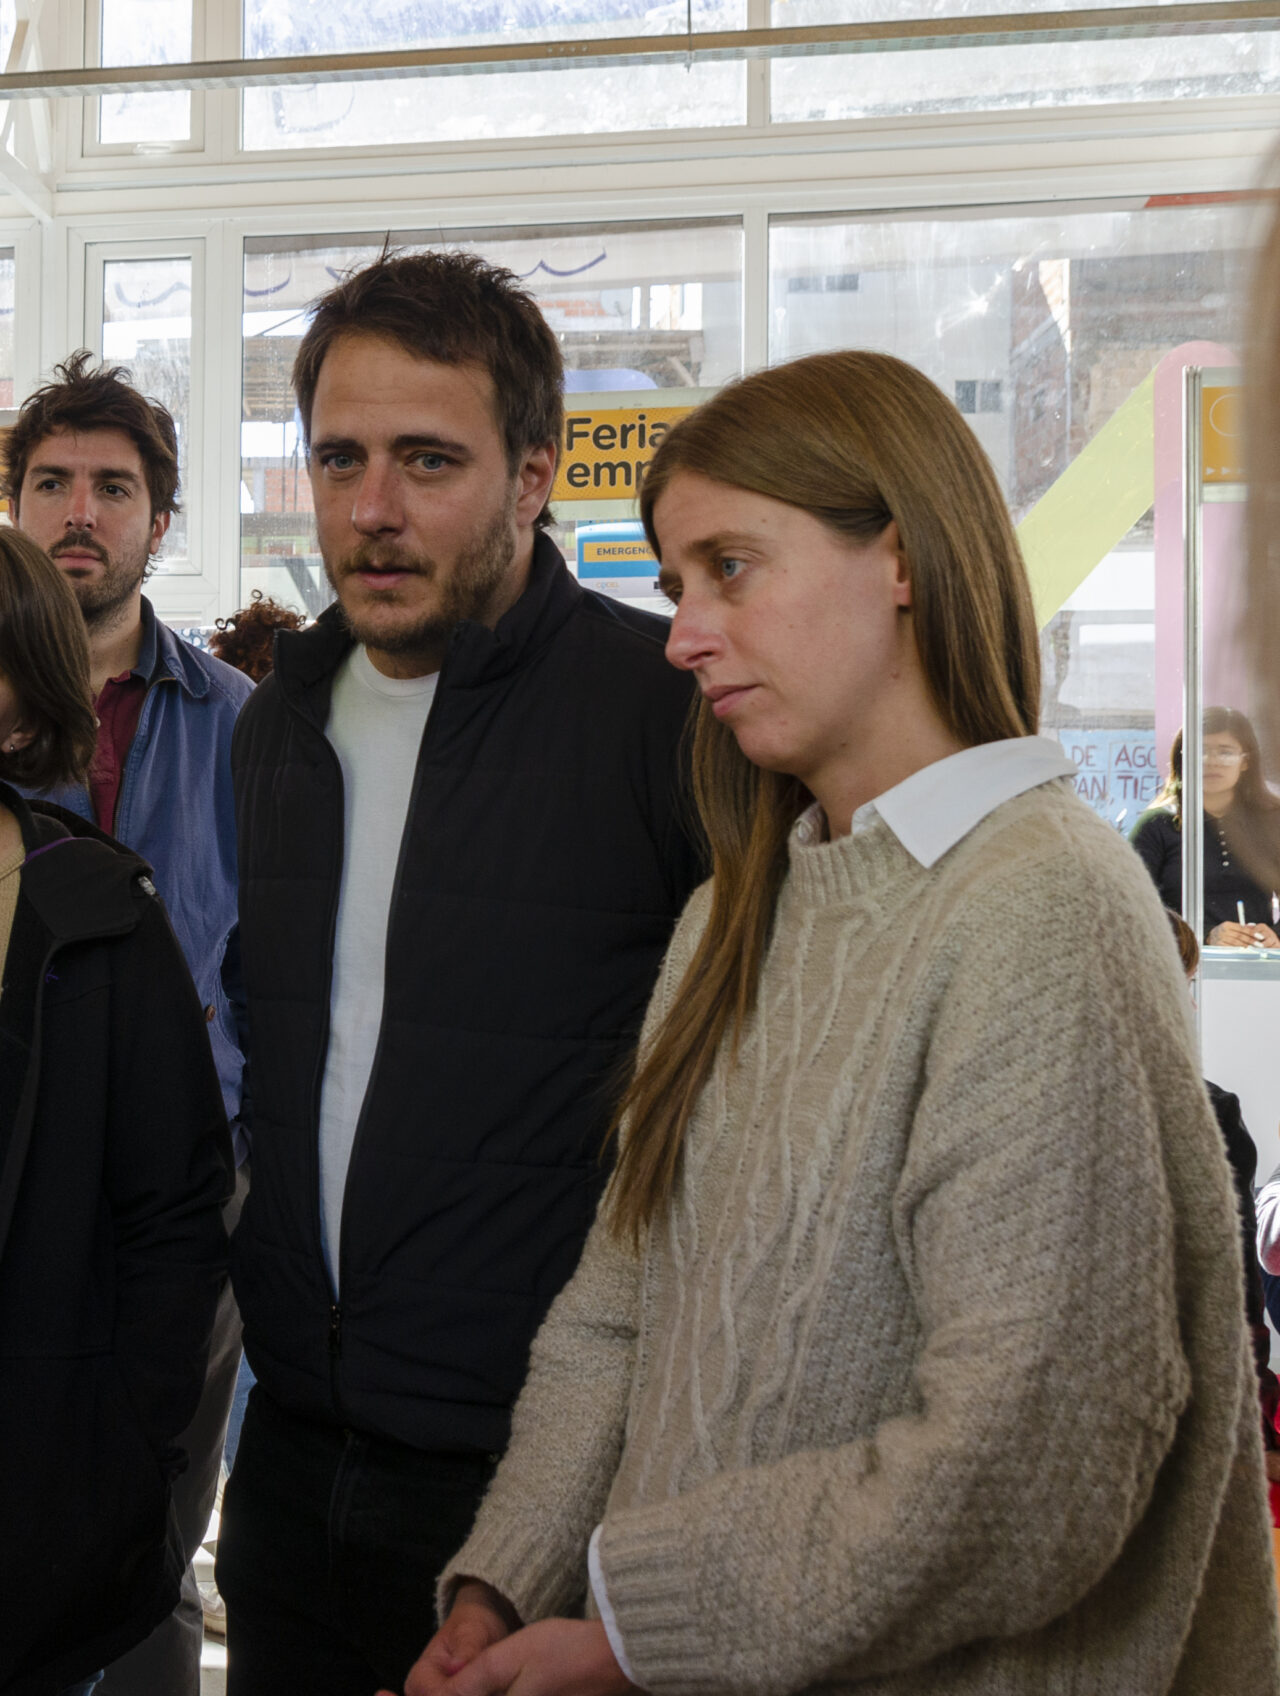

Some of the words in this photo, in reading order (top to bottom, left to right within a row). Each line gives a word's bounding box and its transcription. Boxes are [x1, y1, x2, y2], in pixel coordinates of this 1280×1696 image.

[565, 414, 670, 451] Feria
[1072, 745, 1097, 767] DE
[1073, 775, 1114, 805] AN,
